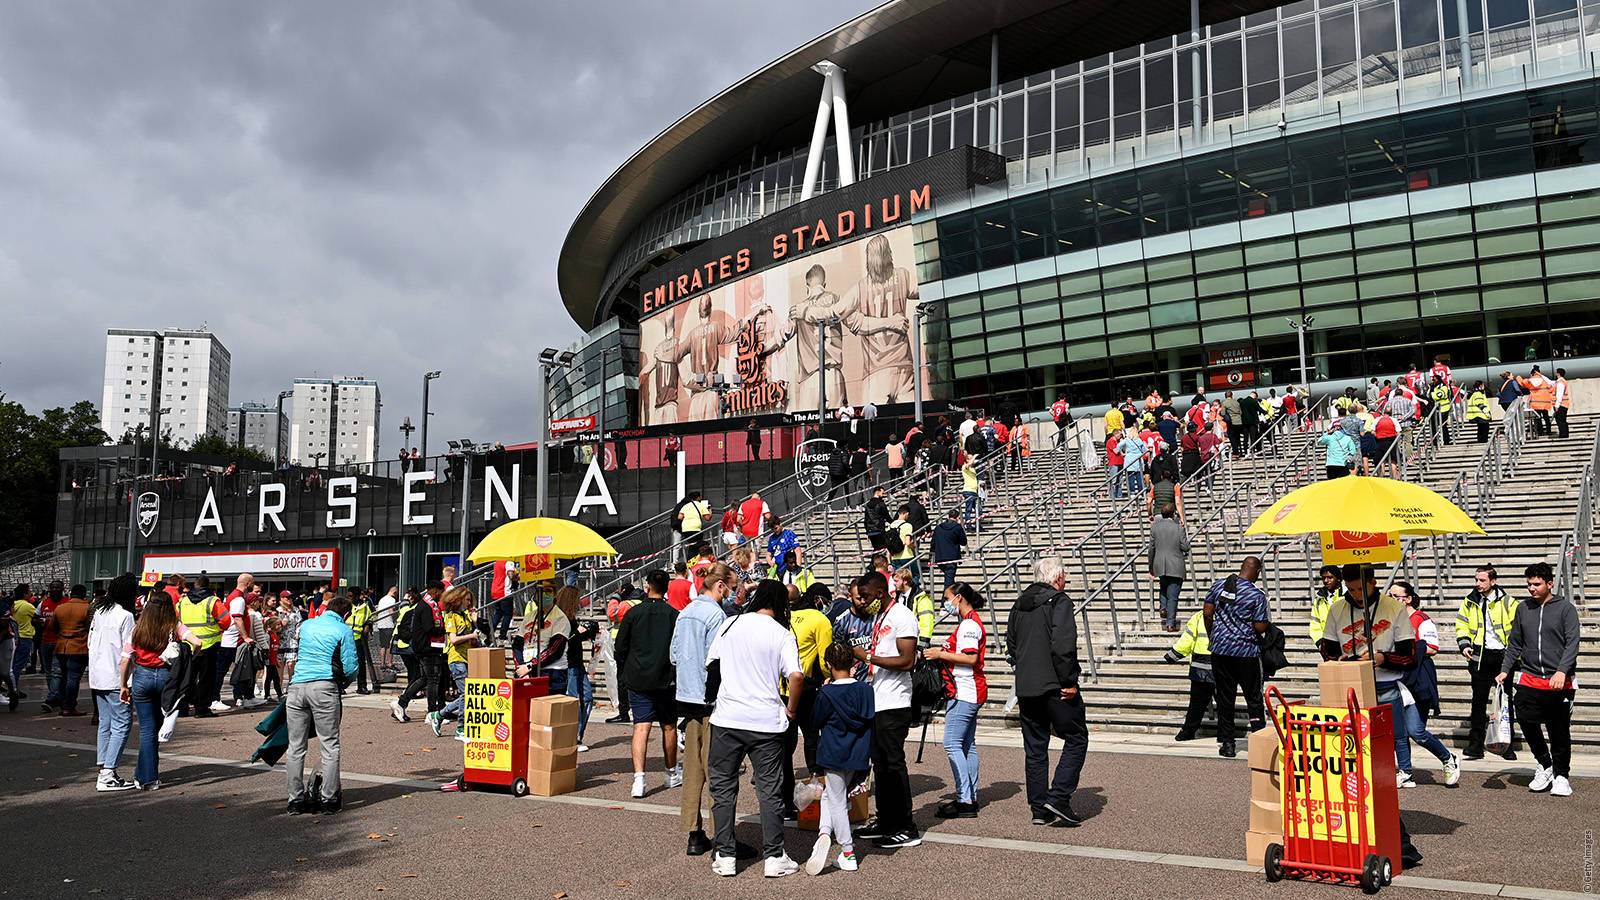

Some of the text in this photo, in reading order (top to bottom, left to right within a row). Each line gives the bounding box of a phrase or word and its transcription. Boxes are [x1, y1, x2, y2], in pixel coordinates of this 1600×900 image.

[643, 184, 931, 313] EMIRATES STADIUM
[726, 380, 785, 412] mirates
[794, 414, 806, 422] The
[801, 453, 831, 463] Arsen
[273, 556, 317, 569] BOX OFFICE
[467, 683, 496, 696] READ
[466, 697, 487, 710] ALL
[466, 711, 505, 725] ABOUT
[466, 726, 481, 739] IT!
[466, 749, 487, 760] £3.50
